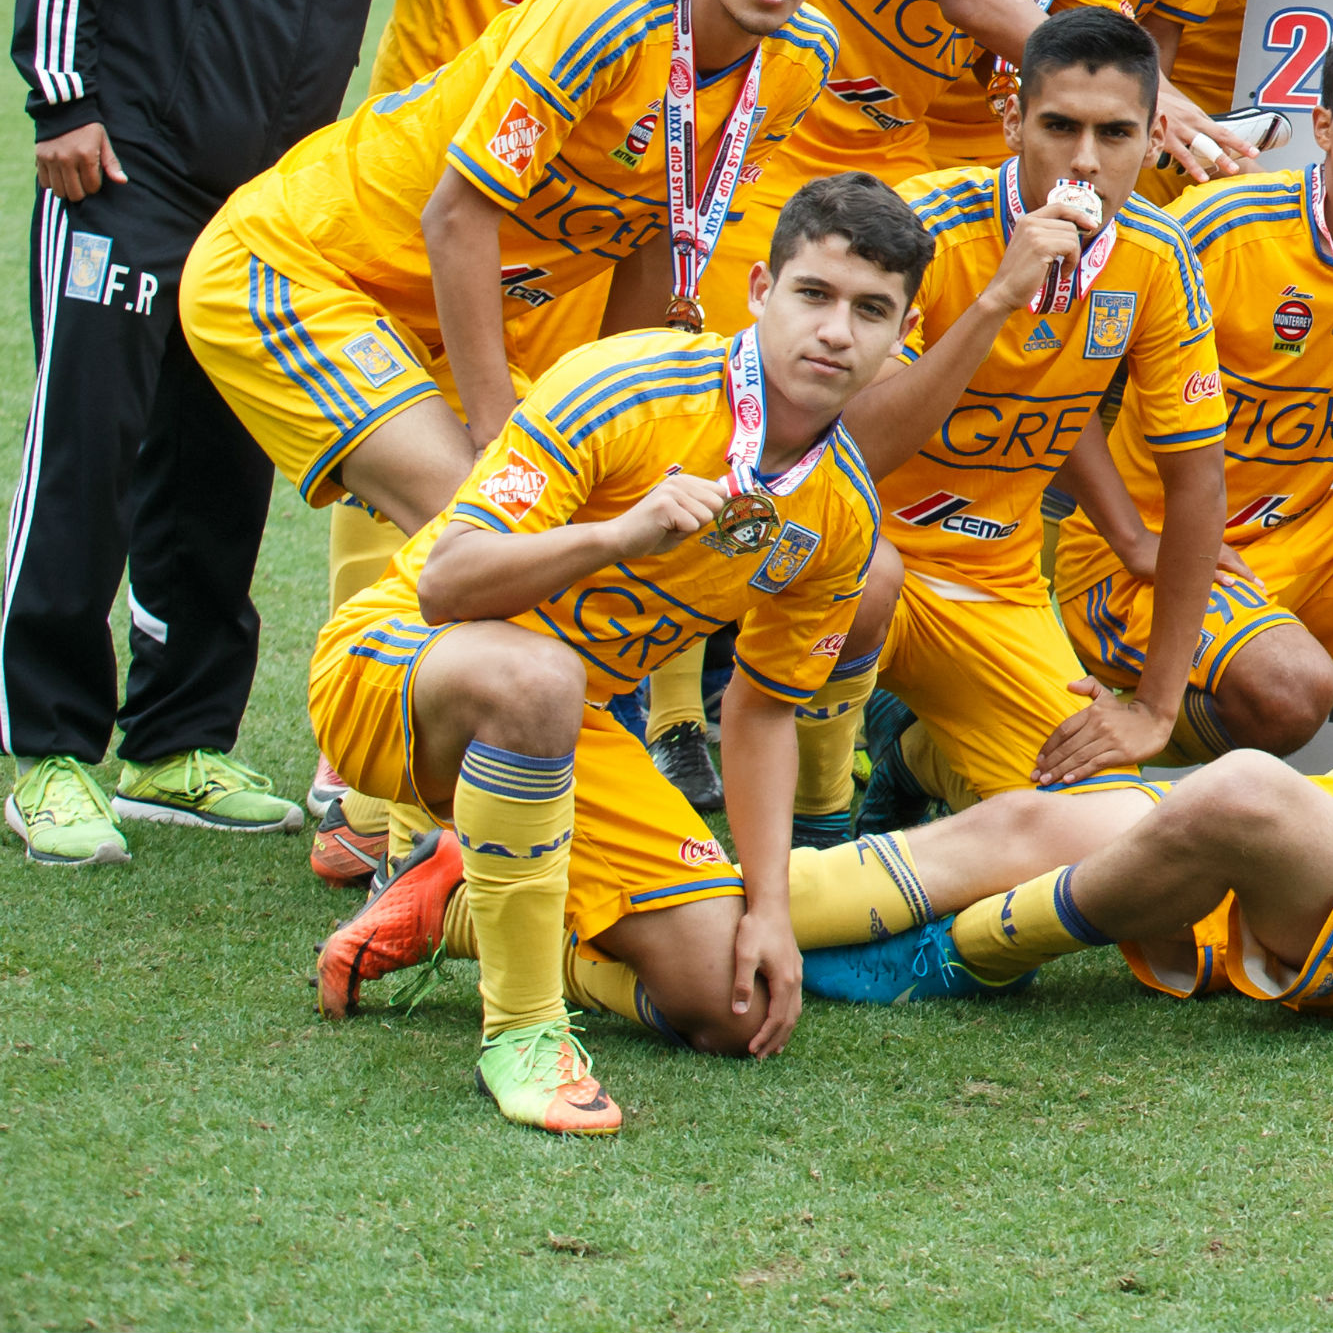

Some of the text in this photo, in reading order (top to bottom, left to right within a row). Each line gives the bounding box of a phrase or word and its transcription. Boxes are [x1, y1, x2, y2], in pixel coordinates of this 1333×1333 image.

[494, 124, 541, 153] HOME
[670, 103, 684, 225] DALLAS CUP XXXIX
[704, 121, 748, 236] DALLAS CUP XXXIX
[1010, 191, 1022, 215] CUP
[102, 264, 159, 316] F.R
[1095, 295, 1133, 309] TIGRES
[1273, 312, 1313, 330] MONTERREY
[1023, 338, 1062, 352] adidas
[1273, 342, 1301, 354] EXTRA
[744, 347, 759, 388] XXXIX
[481, 472, 546, 494] HOME
